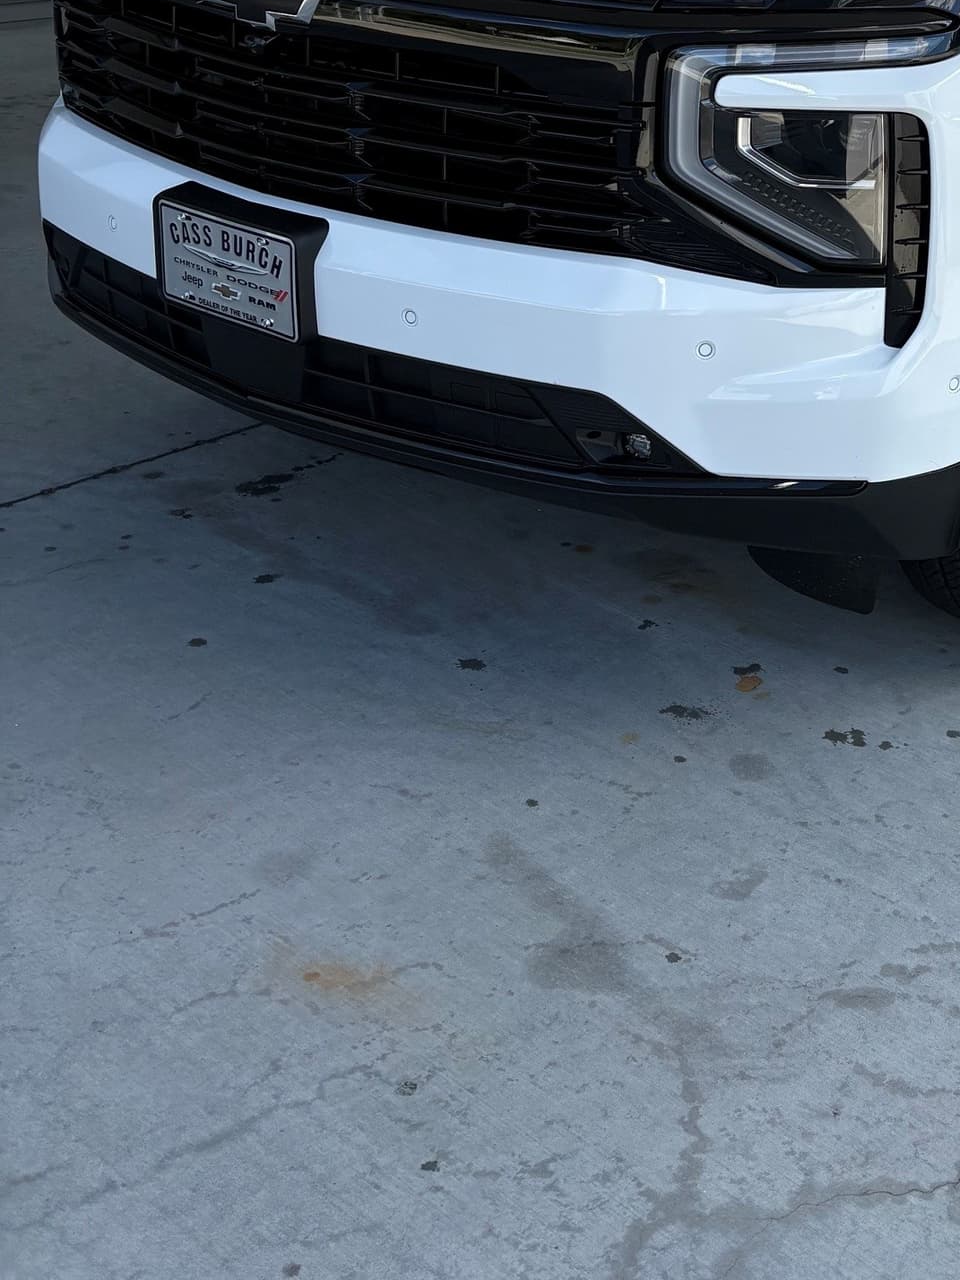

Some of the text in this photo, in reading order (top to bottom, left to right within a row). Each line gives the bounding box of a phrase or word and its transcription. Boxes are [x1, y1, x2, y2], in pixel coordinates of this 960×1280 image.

[169, 221, 283, 279] CASS BURCH
[174, 256, 218, 277] CHRYSLER
[182, 271, 204, 289] Jeep
[226, 274, 278, 297] DODGE
[198, 297, 257, 323] DEALER OF THE YEAR
[248, 295, 276, 311] RAM
